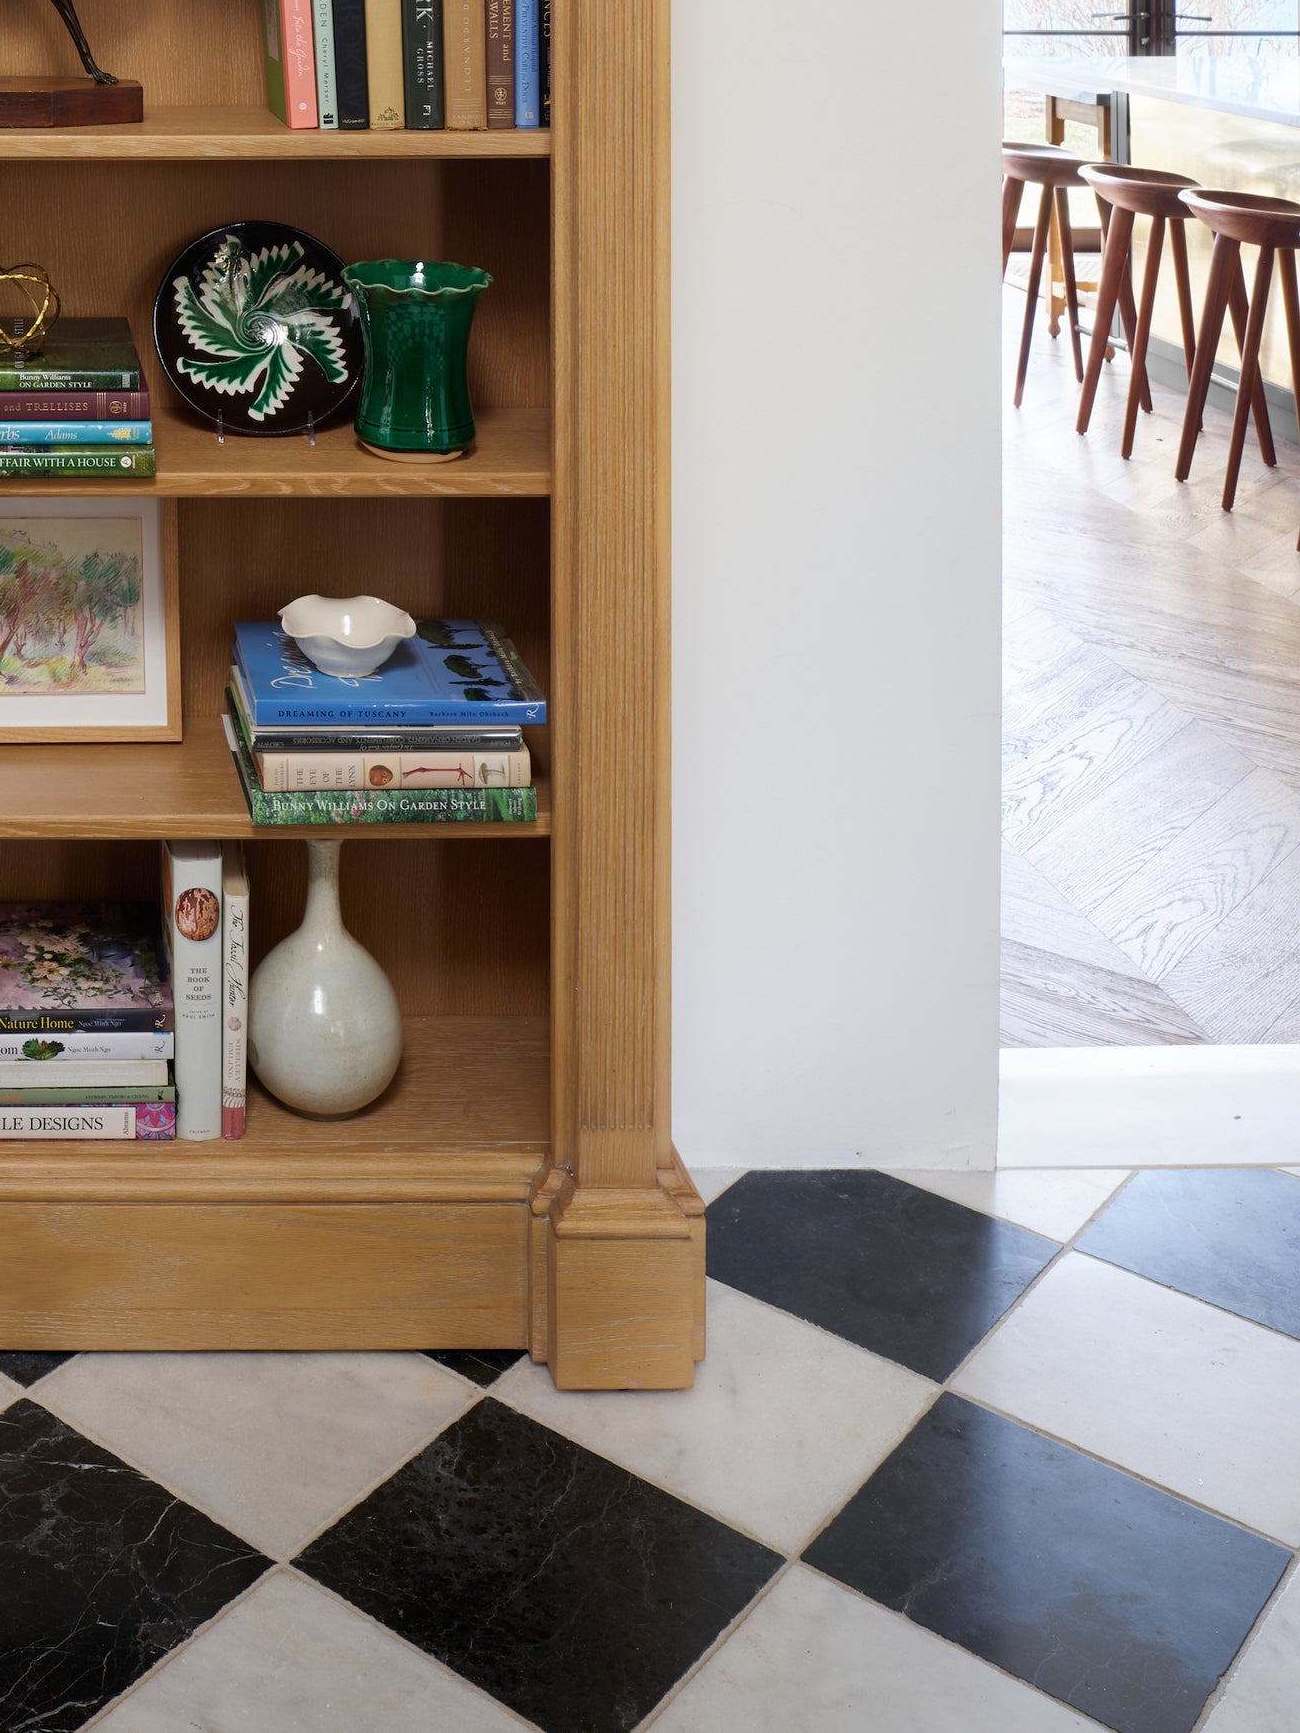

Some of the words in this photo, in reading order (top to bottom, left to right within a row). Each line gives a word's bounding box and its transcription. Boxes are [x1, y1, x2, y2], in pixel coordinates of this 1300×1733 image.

[321, 37, 330, 68] Cheryl
[503, 43, 512, 62] and
[416, 48, 425, 84] GROSS
[426, 40, 435, 91] MICHAEL
[19, 373, 41, 381] Bunny
[43, 372, 72, 380] Williams
[33, 381, 67, 389] GARDEN
[69, 381, 93, 389] STYLE
[4, 403, 21, 412] and
[26, 402, 89, 412] TRELLISES
[44, 428, 78, 440] Adams
[33, 458, 65, 467] WITH
[67, 458, 77, 467] A
[77, 458, 116, 467] HOUSE
[278, 710, 335, 718] DREAMING
[339, 710, 354, 718] OF
[357, 710, 407, 718] TUSCANY
[296, 768, 304, 787] THE
[309, 768, 317, 786] EYE
[322, 771, 331, 784] OF
[335, 767, 343, 786] THE
[348, 765, 356, 788] LYNX
[272, 799, 315, 811] BUNNY
[316, 799, 374, 811] WILLIAMS
[376, 799, 397, 811] ON
[400, 798, 448, 811] GARDEN
[450, 798, 487, 811] STYLE
[189, 967, 208, 975] THE
[192, 985, 205, 993] OF
[185, 994, 212, 1002] SEEDS
[41, 1016, 75, 1029] Home
[29, 1117, 105, 1131] DESIGNS
[122, 1111, 130, 1136] Abrams
